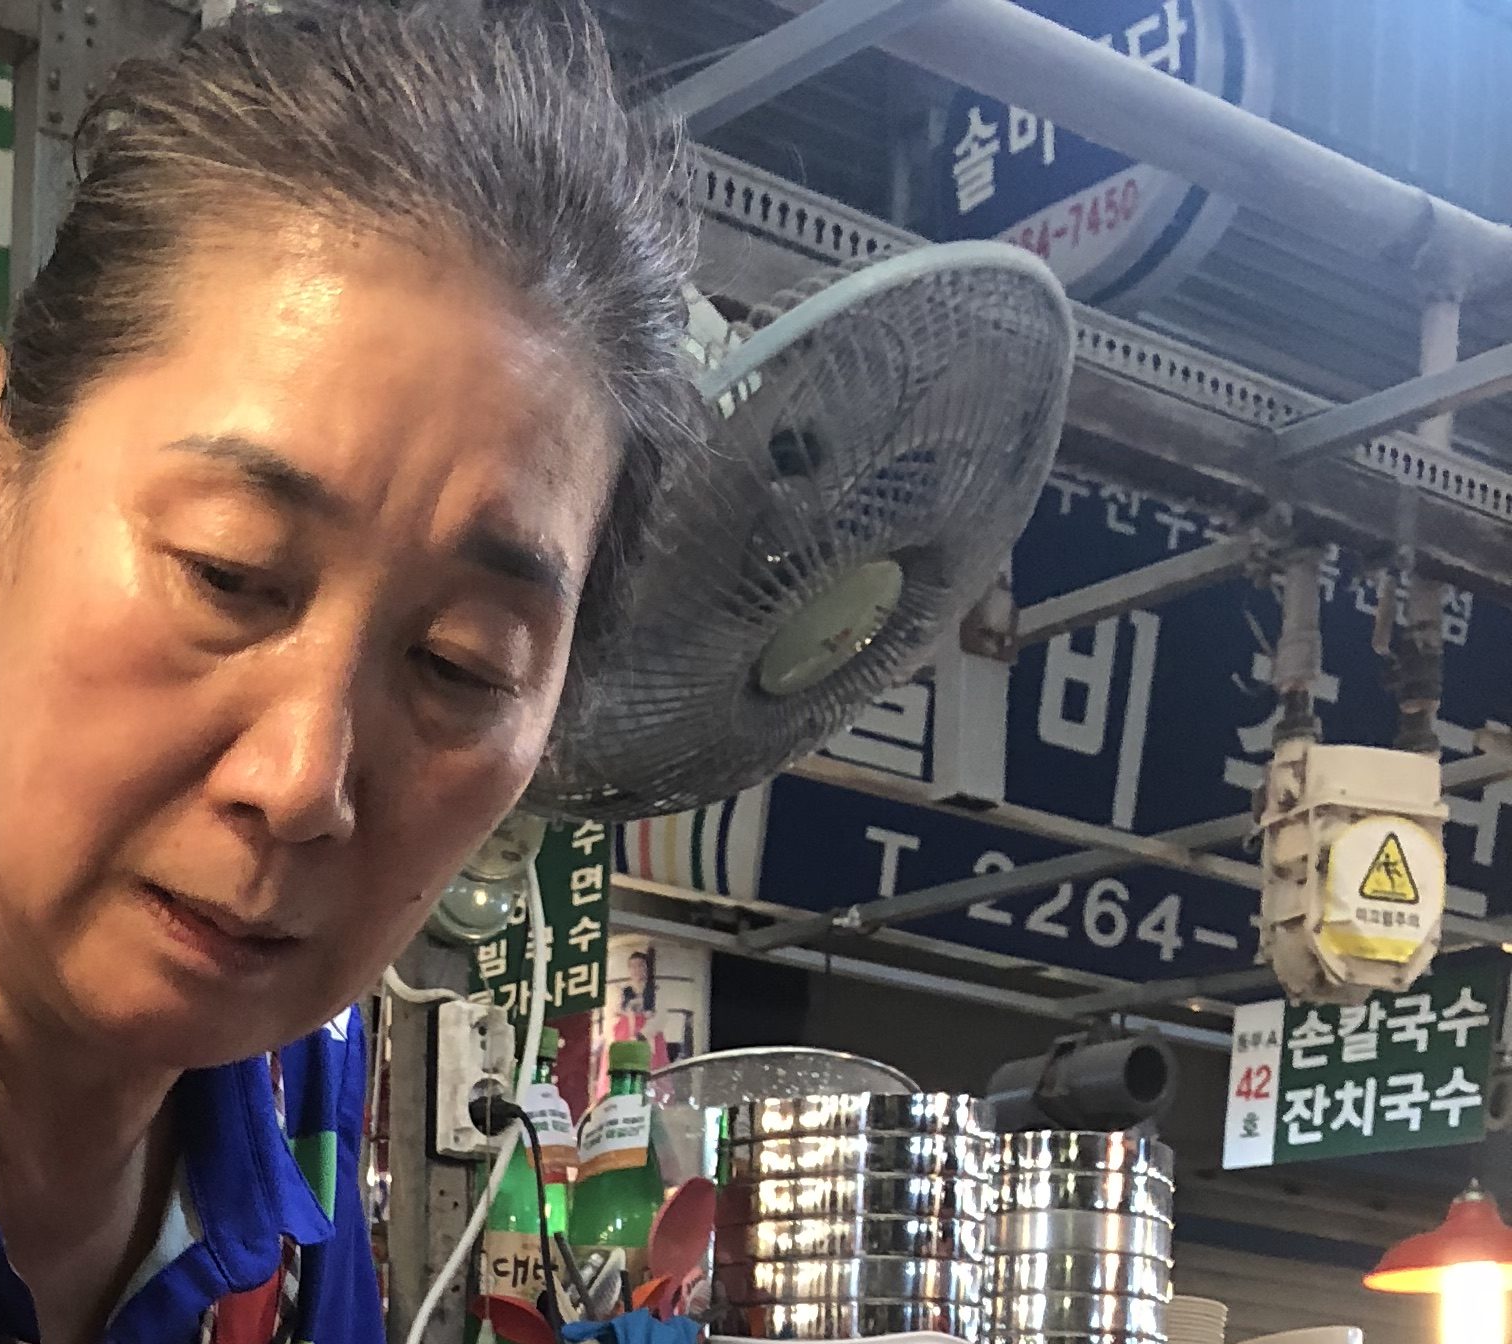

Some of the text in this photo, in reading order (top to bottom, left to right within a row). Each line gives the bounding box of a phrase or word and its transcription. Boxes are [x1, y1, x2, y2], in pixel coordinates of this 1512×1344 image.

[865, 825, 922, 897] T
[1288, 986, 1489, 1070] 손칼국수
[1235, 1064, 1272, 1101] 42
[1282, 1066, 1482, 1145] 잔치국수
